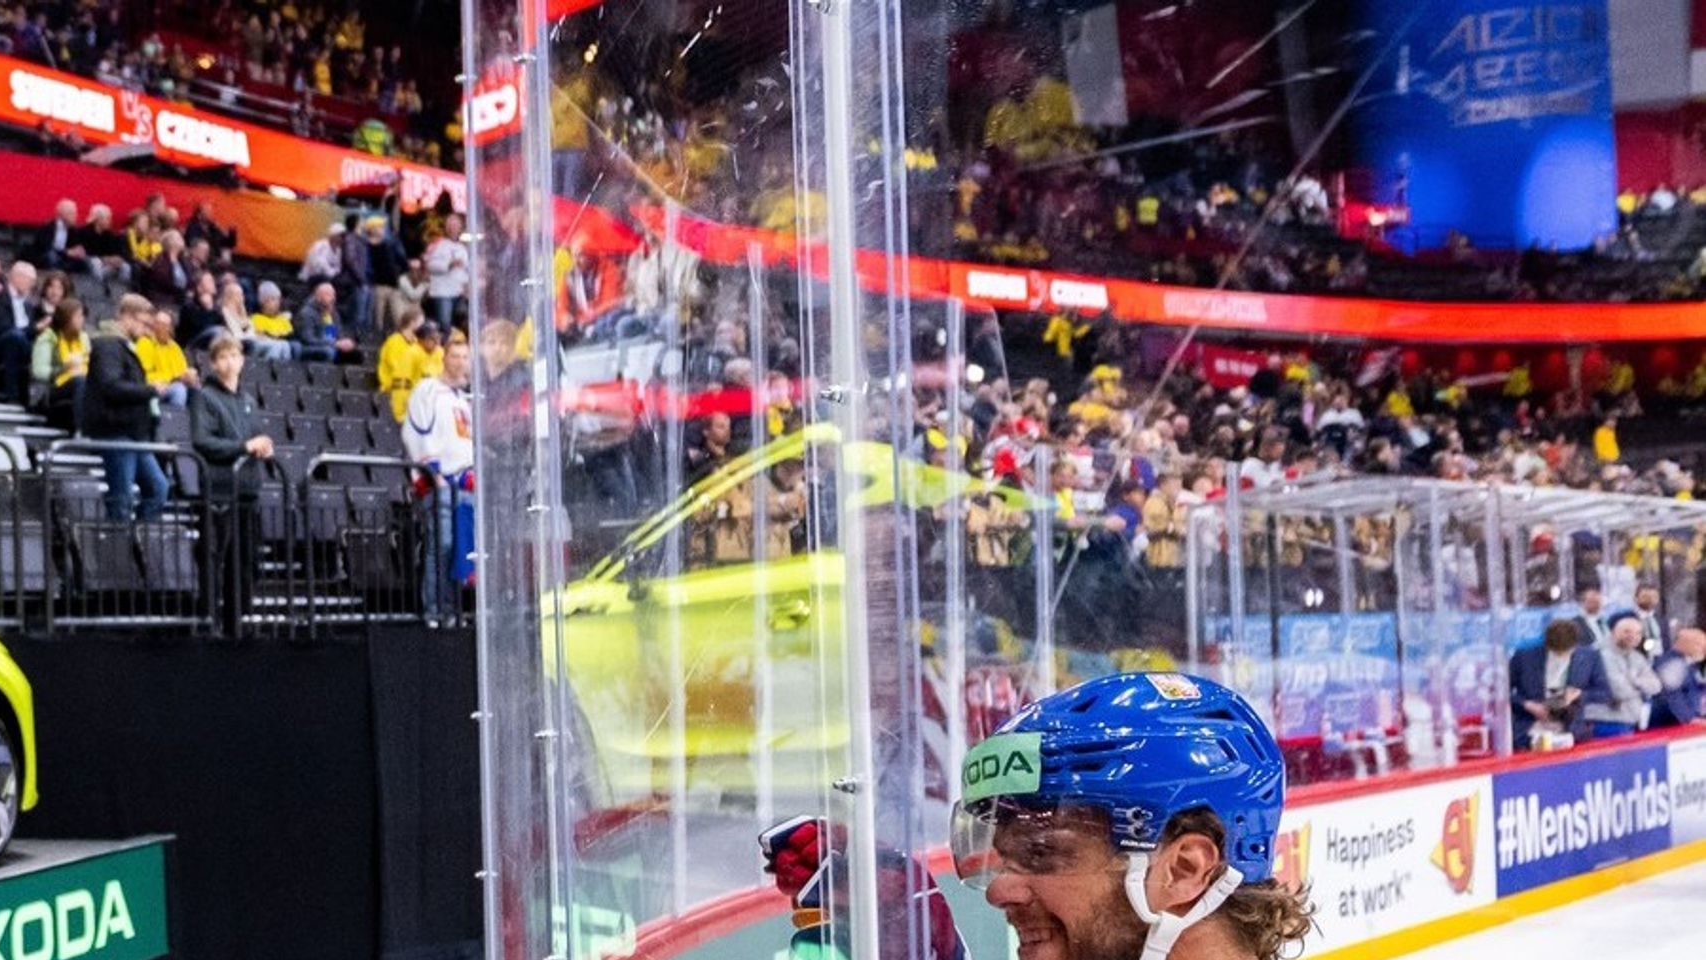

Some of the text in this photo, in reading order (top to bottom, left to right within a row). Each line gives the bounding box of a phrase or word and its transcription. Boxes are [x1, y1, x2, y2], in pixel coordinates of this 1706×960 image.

[962, 750, 1034, 787] ODA
[1497, 768, 1671, 870] #MensWorlds
[1326, 818, 1415, 869] Happiness
[1338, 885, 1357, 917] at
